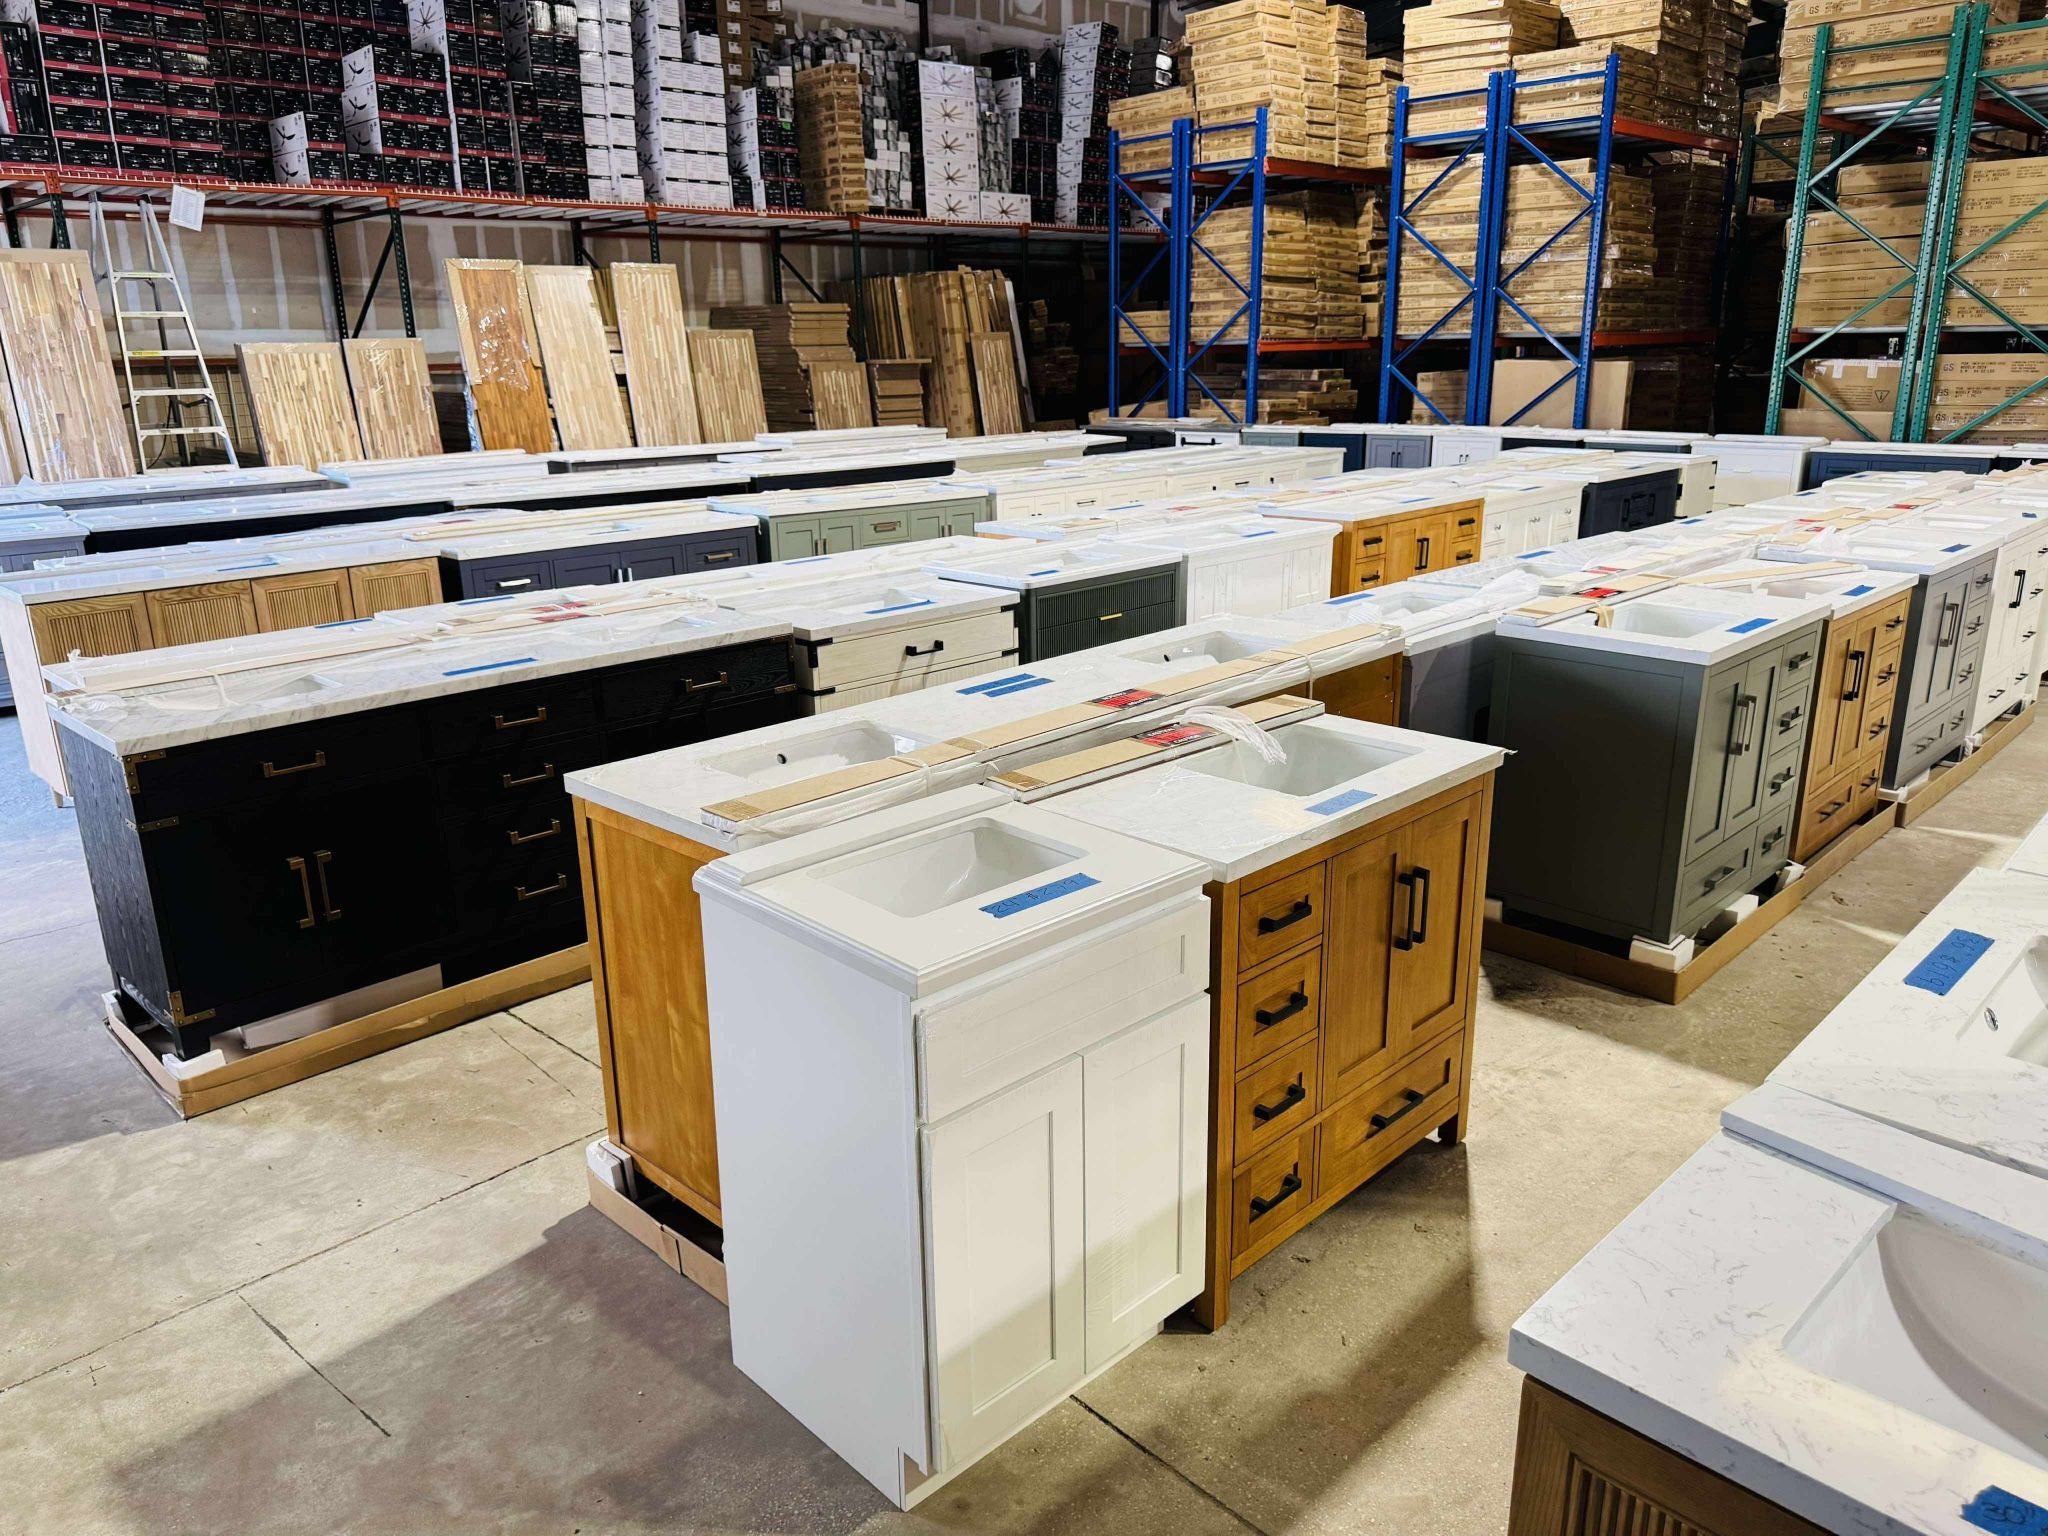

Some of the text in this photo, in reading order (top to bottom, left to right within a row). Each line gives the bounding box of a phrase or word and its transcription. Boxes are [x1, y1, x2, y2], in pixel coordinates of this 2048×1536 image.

[1809, 6, 1820, 15] GS
[1943, 363, 1955, 372] GS
[1935, 413, 1947, 422] GS
